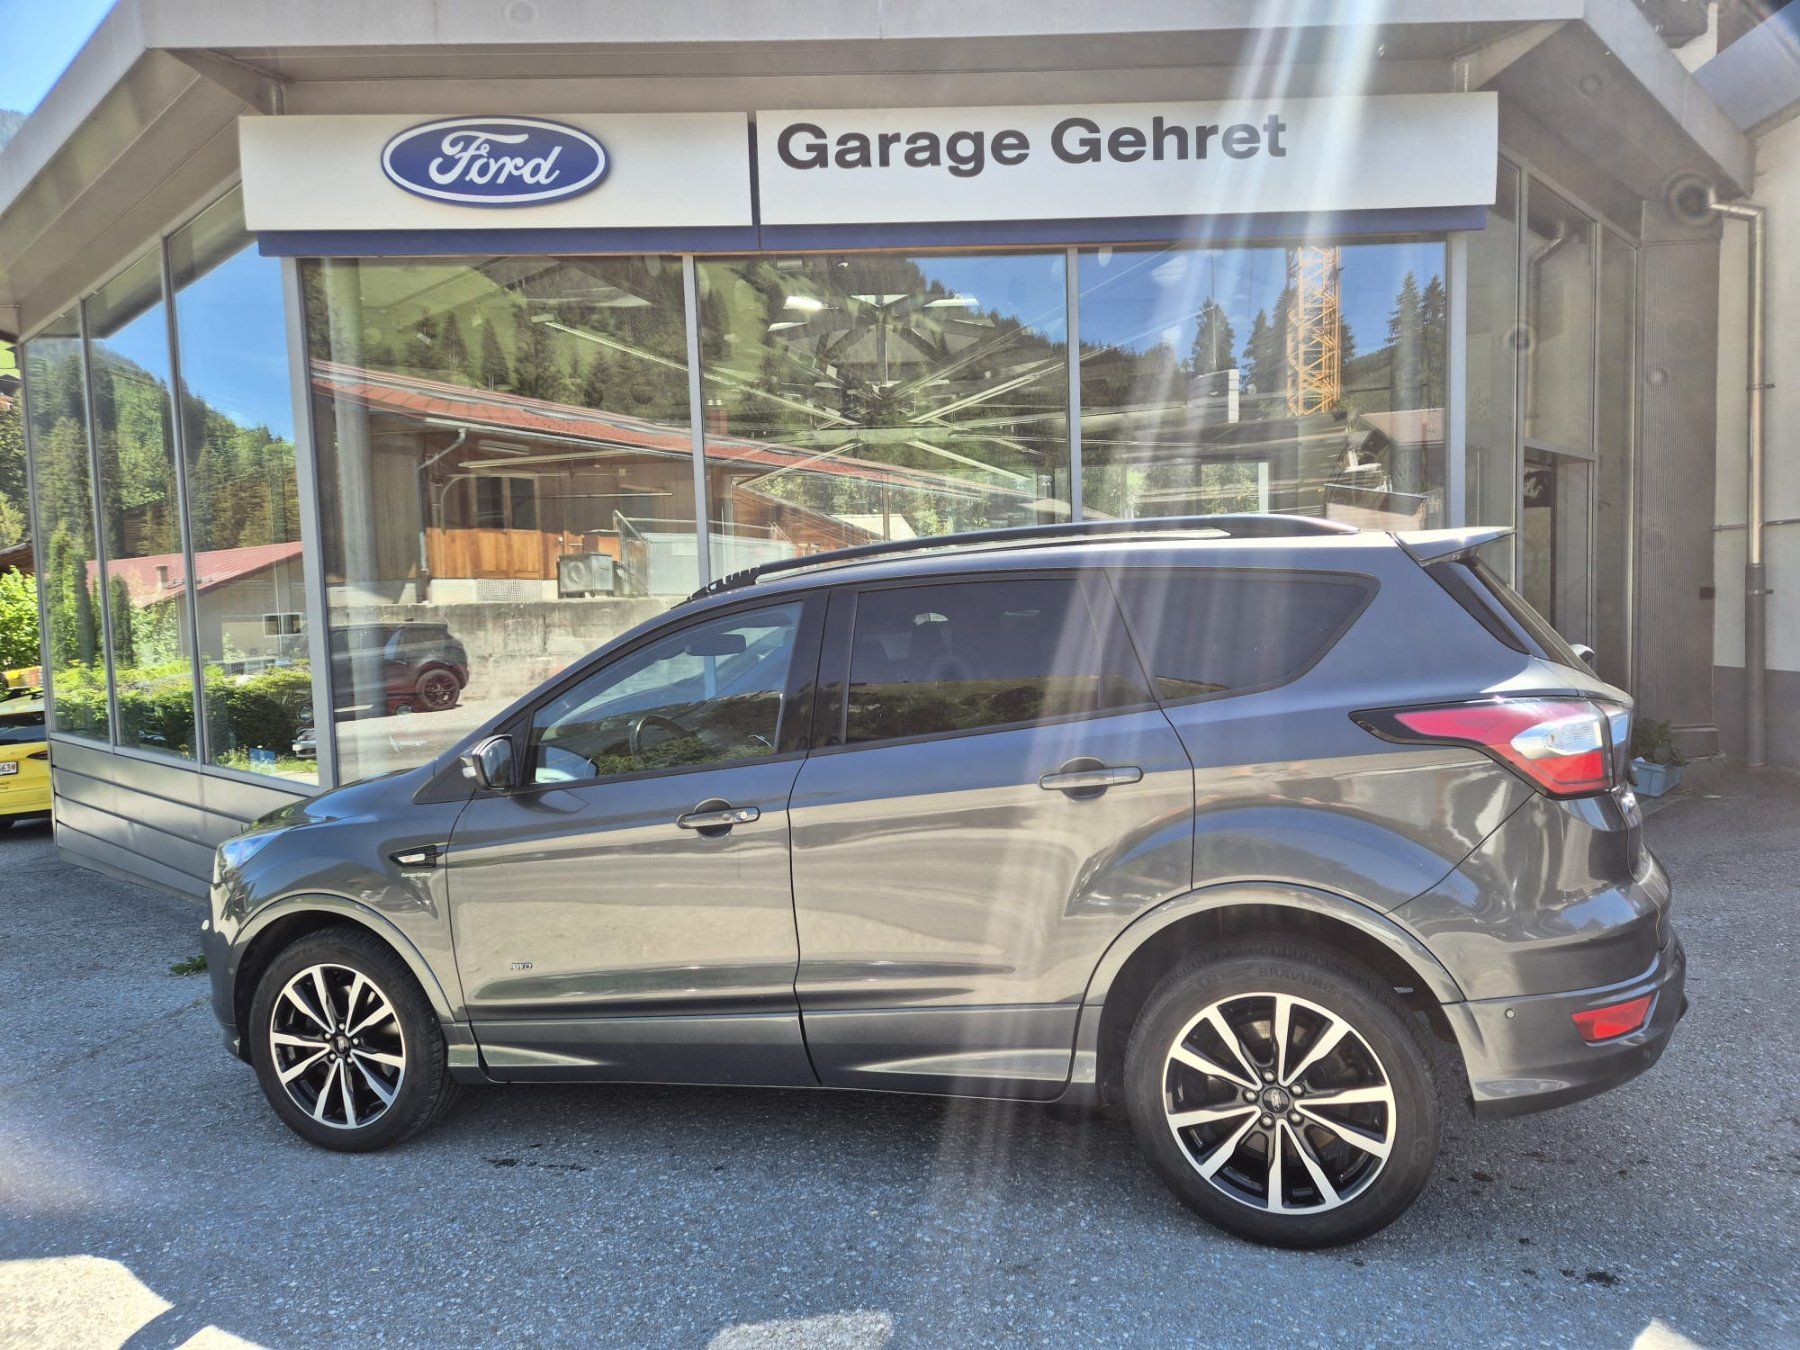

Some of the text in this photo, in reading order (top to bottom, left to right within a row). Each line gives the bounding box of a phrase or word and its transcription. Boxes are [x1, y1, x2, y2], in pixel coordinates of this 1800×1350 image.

[428, 130, 564, 185] Ford
[776, 114, 1287, 178] Garage Gehret
